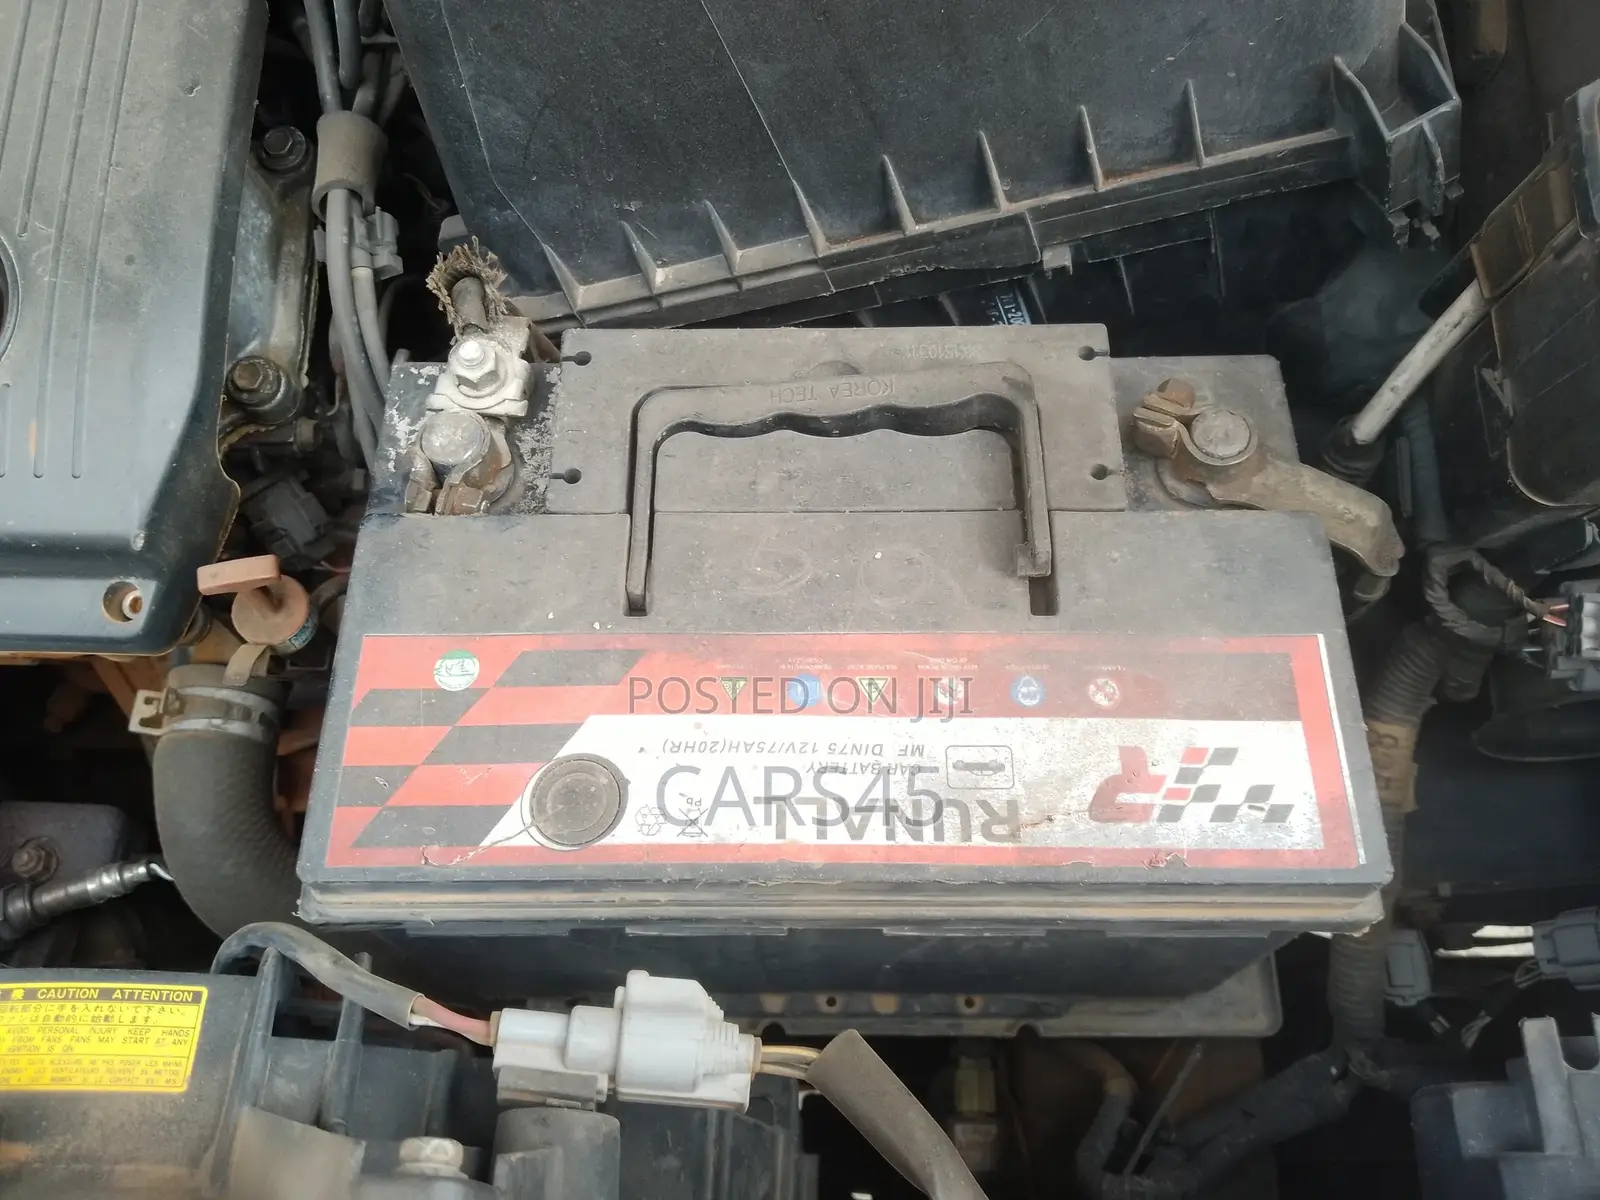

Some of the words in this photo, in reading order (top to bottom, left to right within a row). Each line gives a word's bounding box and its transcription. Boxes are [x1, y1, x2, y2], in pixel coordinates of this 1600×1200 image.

[769, 384, 817, 405] TECH
[828, 379, 896, 398] KOREA
[662, 738, 819, 756] 12V/75AH(20HR)
[828, 742, 884, 757] DIN75
[898, 743, 925, 757] MF
[806, 760, 884, 776] BATTERY
[686, 797, 702, 807] Pb
[37, 988, 100, 999] CAUTION
[111, 989, 193, 1002] ATTENTION
[37, 1026, 79, 1035] PERSONAL
[128, 1027, 151, 1036] KEEP
[161, 1029, 191, 1038] HANDS
[40, 1035, 63, 1044] FANS
[69, 1035, 92, 1044] FANS
[98, 1035, 115, 1044] MAY
[121, 1036, 151, 1045] START
[171, 1038, 189, 1046] ANY
